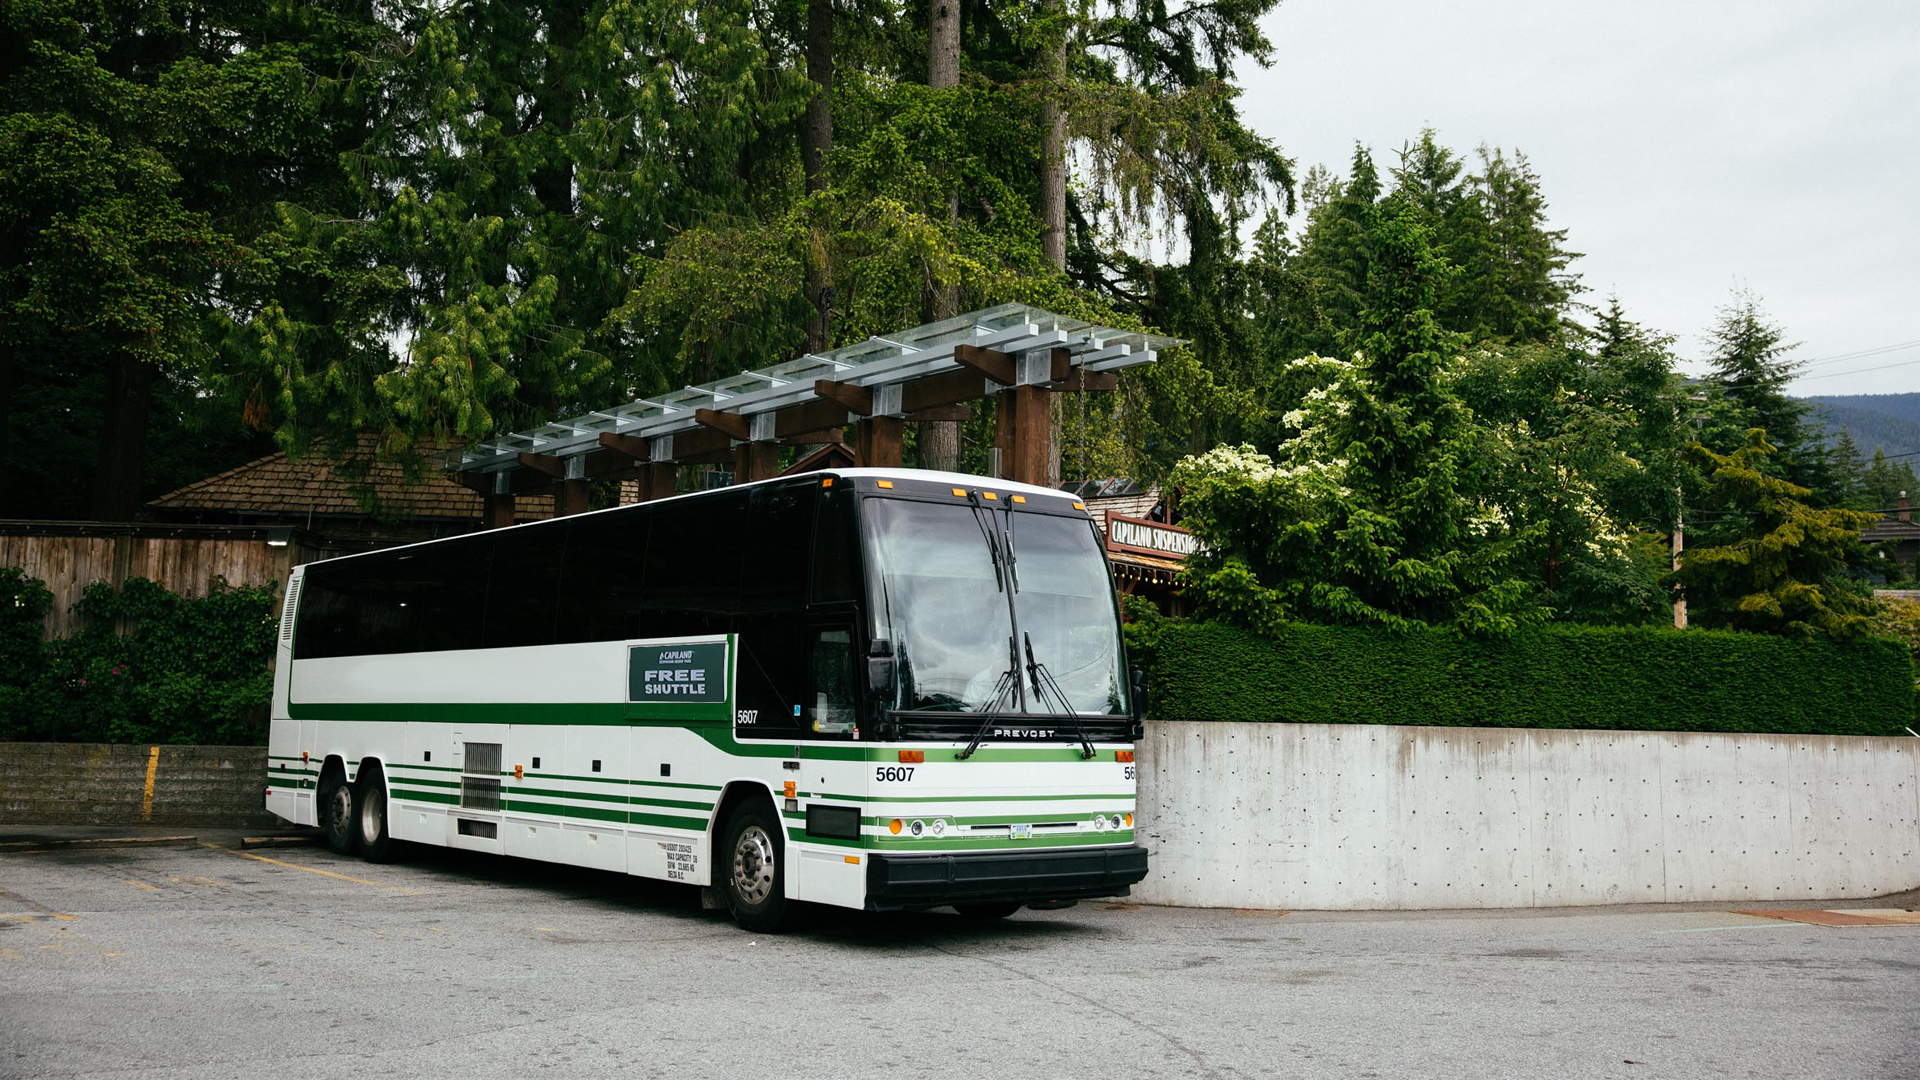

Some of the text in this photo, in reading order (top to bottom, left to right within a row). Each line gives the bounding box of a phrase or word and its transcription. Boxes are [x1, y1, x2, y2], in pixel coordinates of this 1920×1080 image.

[1112, 521, 1152, 548] CAPILANO
[664, 650, 692, 660] CAPILANO
[644, 669, 706, 682] FREE
[644, 683, 706, 695] SHUTTLE
[737, 710, 758, 724] 5607
[994, 729, 1055, 738] PREVOST
[876, 766, 915, 782] 5607
[675, 853, 691, 862] CAPACITY
[668, 870, 677, 878] DELTA
